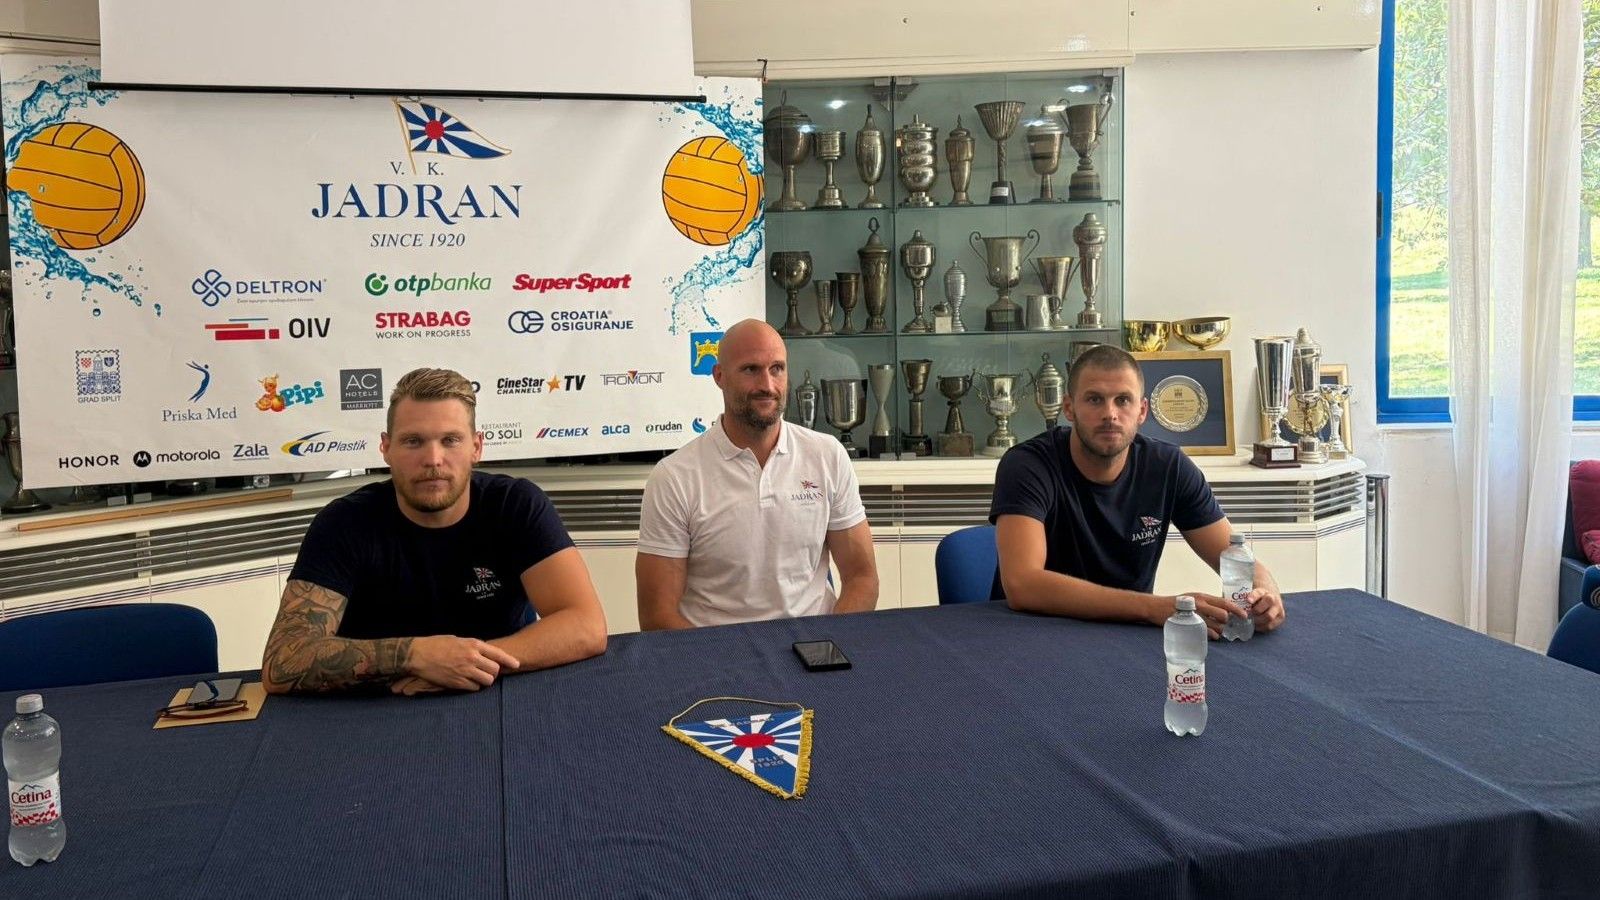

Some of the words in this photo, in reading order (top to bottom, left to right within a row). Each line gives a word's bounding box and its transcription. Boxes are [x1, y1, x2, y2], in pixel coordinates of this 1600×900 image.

[311, 183, 523, 225] JADRAN
[371, 233, 423, 247] SINCE
[430, 233, 466, 247] 1920
[512, 272, 631, 294] SuperSport
[375, 310, 471, 329] STRABAG
[551, 320, 634, 331] OSIGURANJE
[288, 317, 331, 339] OIV
[375, 331, 404, 339] WORK
[425, 329, 471, 338] PROGRESS
[345, 373, 377, 390] AC
[497, 377, 545, 389] CineStar
[564, 375, 586, 391] TV
[162, 409, 201, 422] Priska
[207, 407, 237, 420] Med
[549, 427, 589, 438] CEMEX
[655, 421, 682, 431] rudan
[498, 429, 522, 440] SOLI
[233, 443, 269, 458] Zala
[304, 441, 325, 453] AD
[327, 440, 367, 452] Plastik
[59, 454, 120, 469] HONOR
[156, 450, 220, 463] motorola
[11, 789, 52, 804] Cetina
